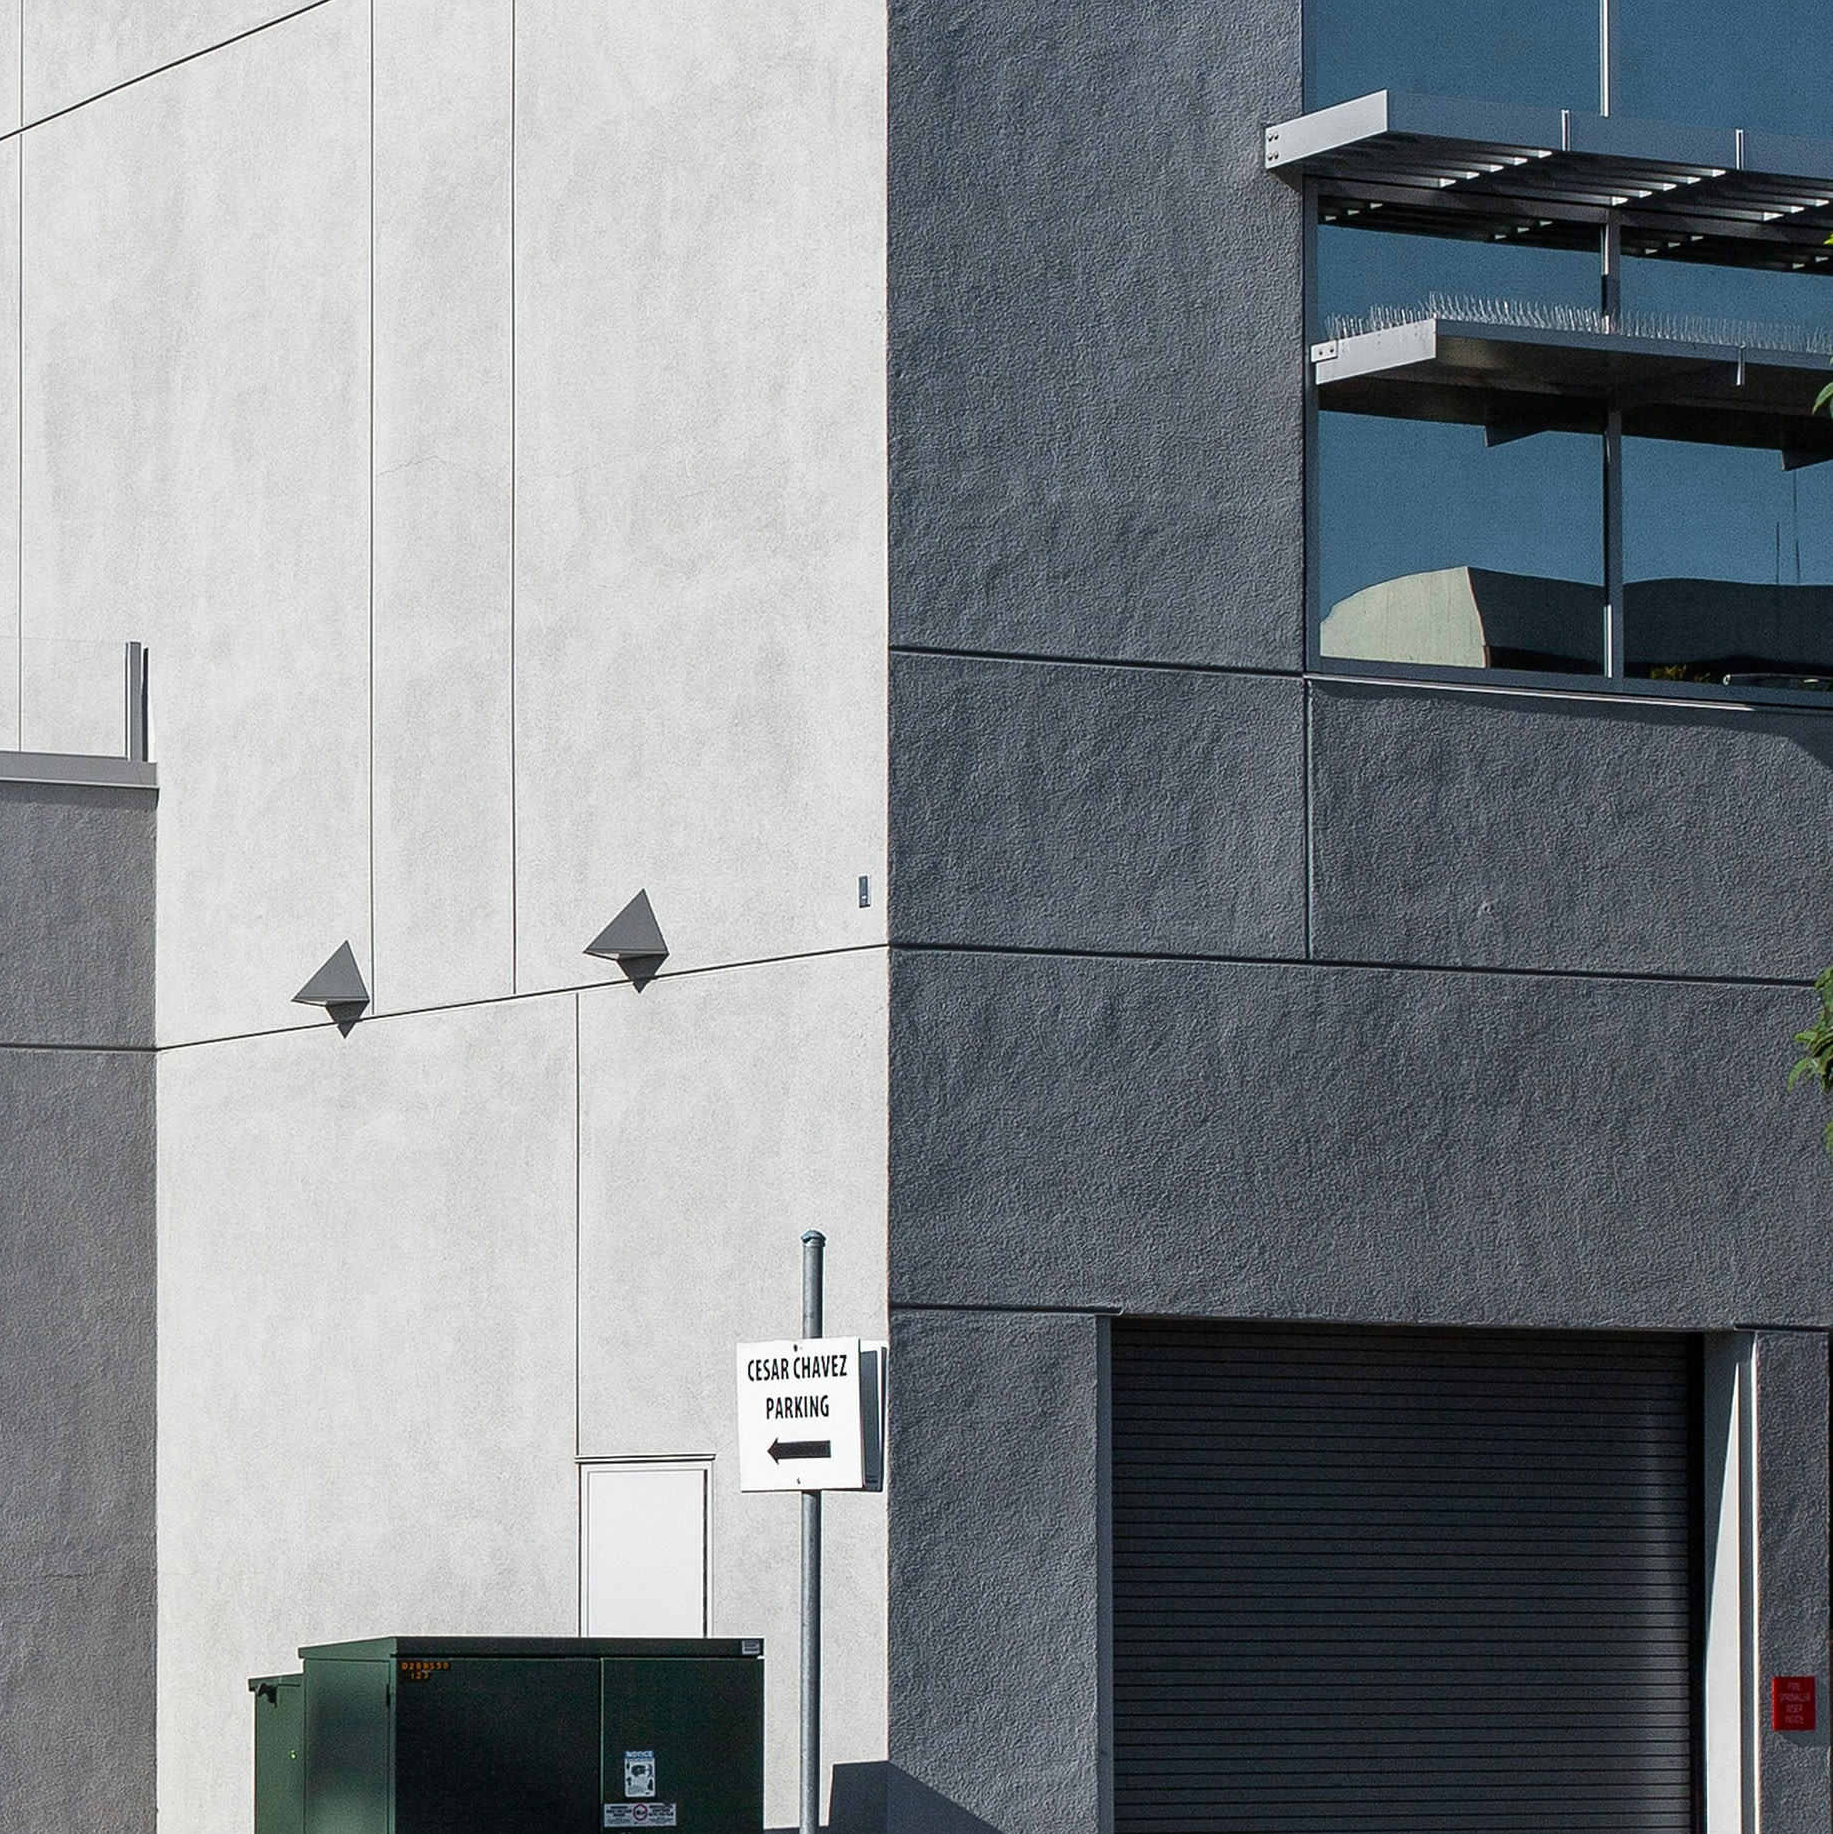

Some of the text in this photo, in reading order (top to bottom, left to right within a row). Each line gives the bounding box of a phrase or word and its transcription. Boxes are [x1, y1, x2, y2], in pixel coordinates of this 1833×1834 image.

[747, 1354, 848, 1382] CESAR CHAVEZ
[766, 1394, 829, 1420] PARKING
